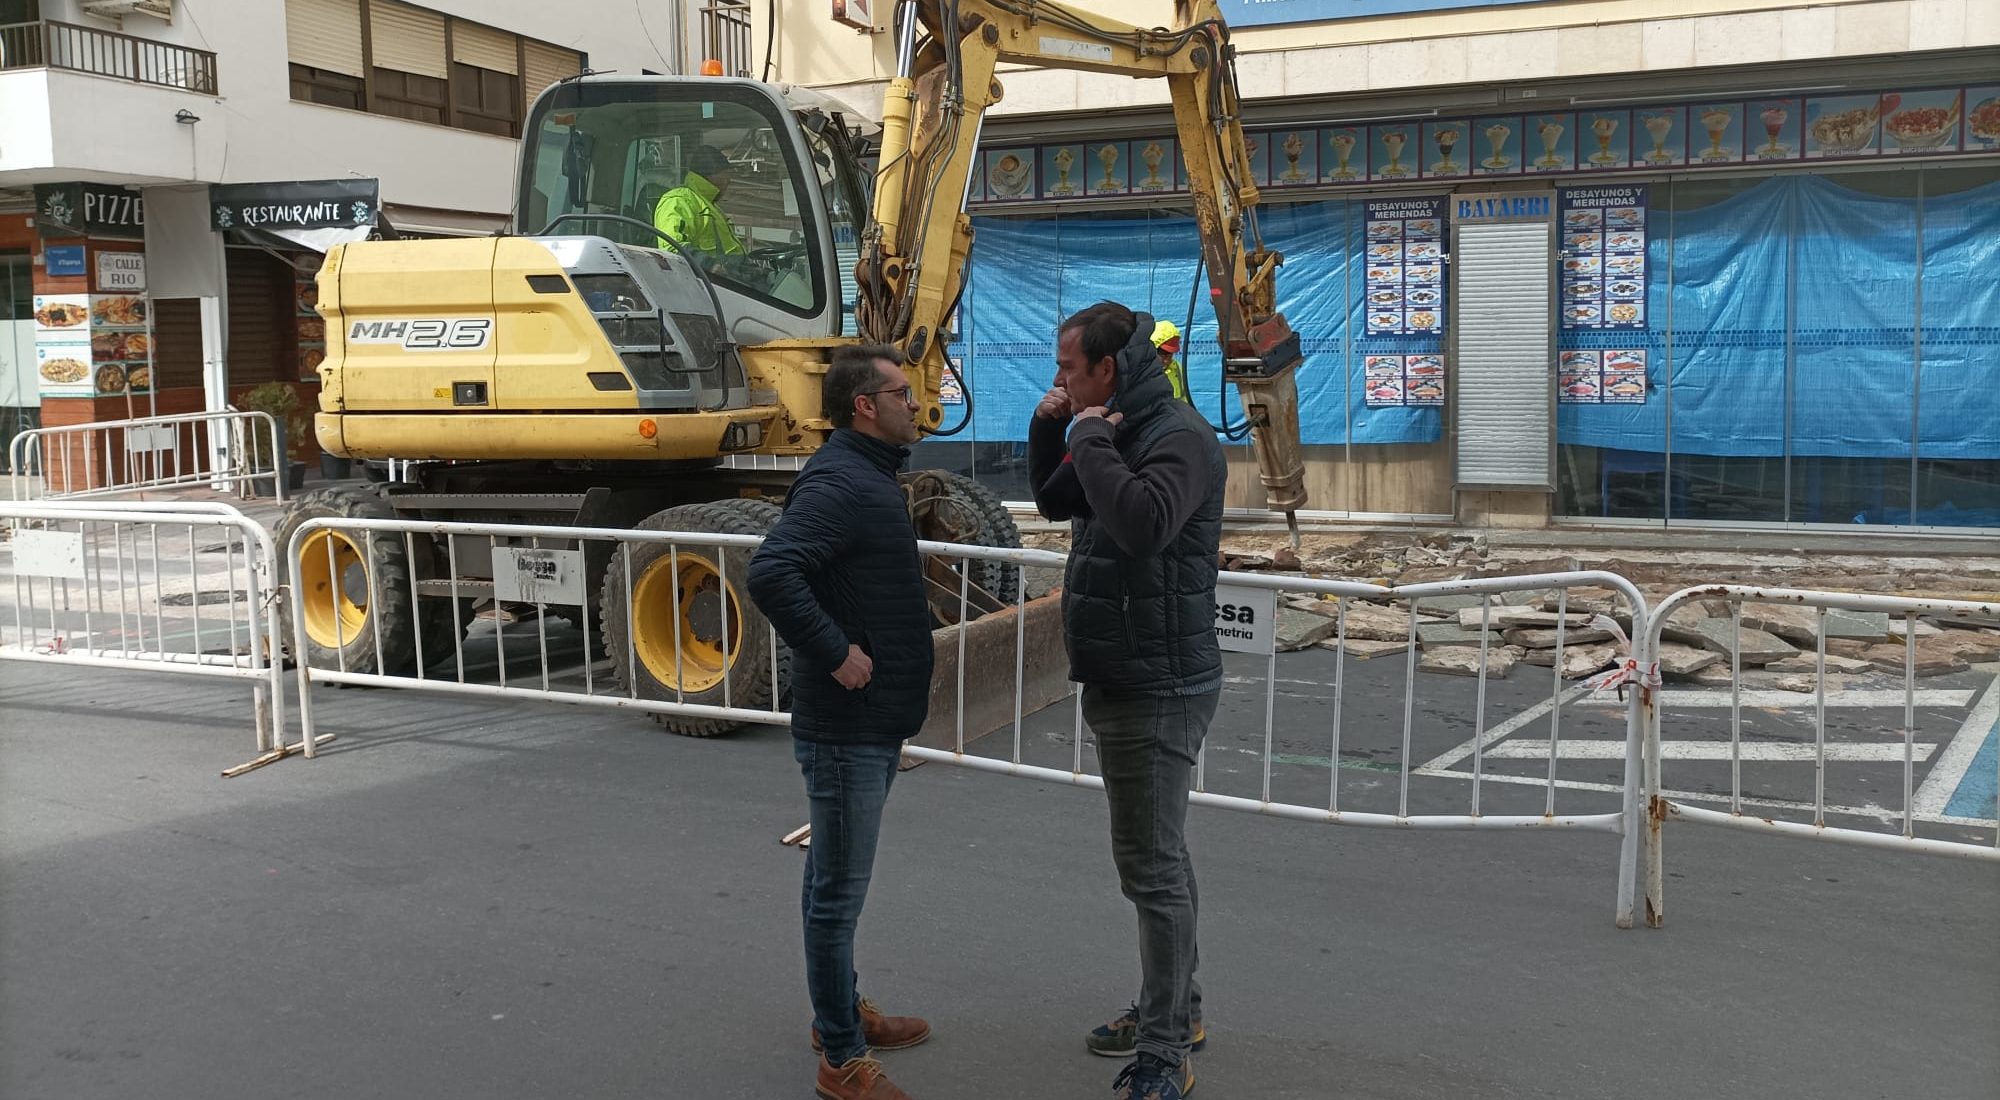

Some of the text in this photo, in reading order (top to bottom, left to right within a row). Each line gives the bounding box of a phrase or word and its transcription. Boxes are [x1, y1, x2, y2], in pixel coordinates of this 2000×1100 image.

[1566, 188, 1643, 199] DESAYUNOS Y
[1369, 200, 1439, 211] DESAYUNOS Y
[1572, 196, 1635, 207] MERIENDAS
[84, 192, 144, 225] PIZZE
[1458, 197, 1549, 218] BAYARRI
[242, 201, 341, 227] RESTAURANTE
[1375, 209, 1433, 219] MERIENDAS
[115, 258, 141, 270] CALLE
[111, 273, 136, 284] RIO
